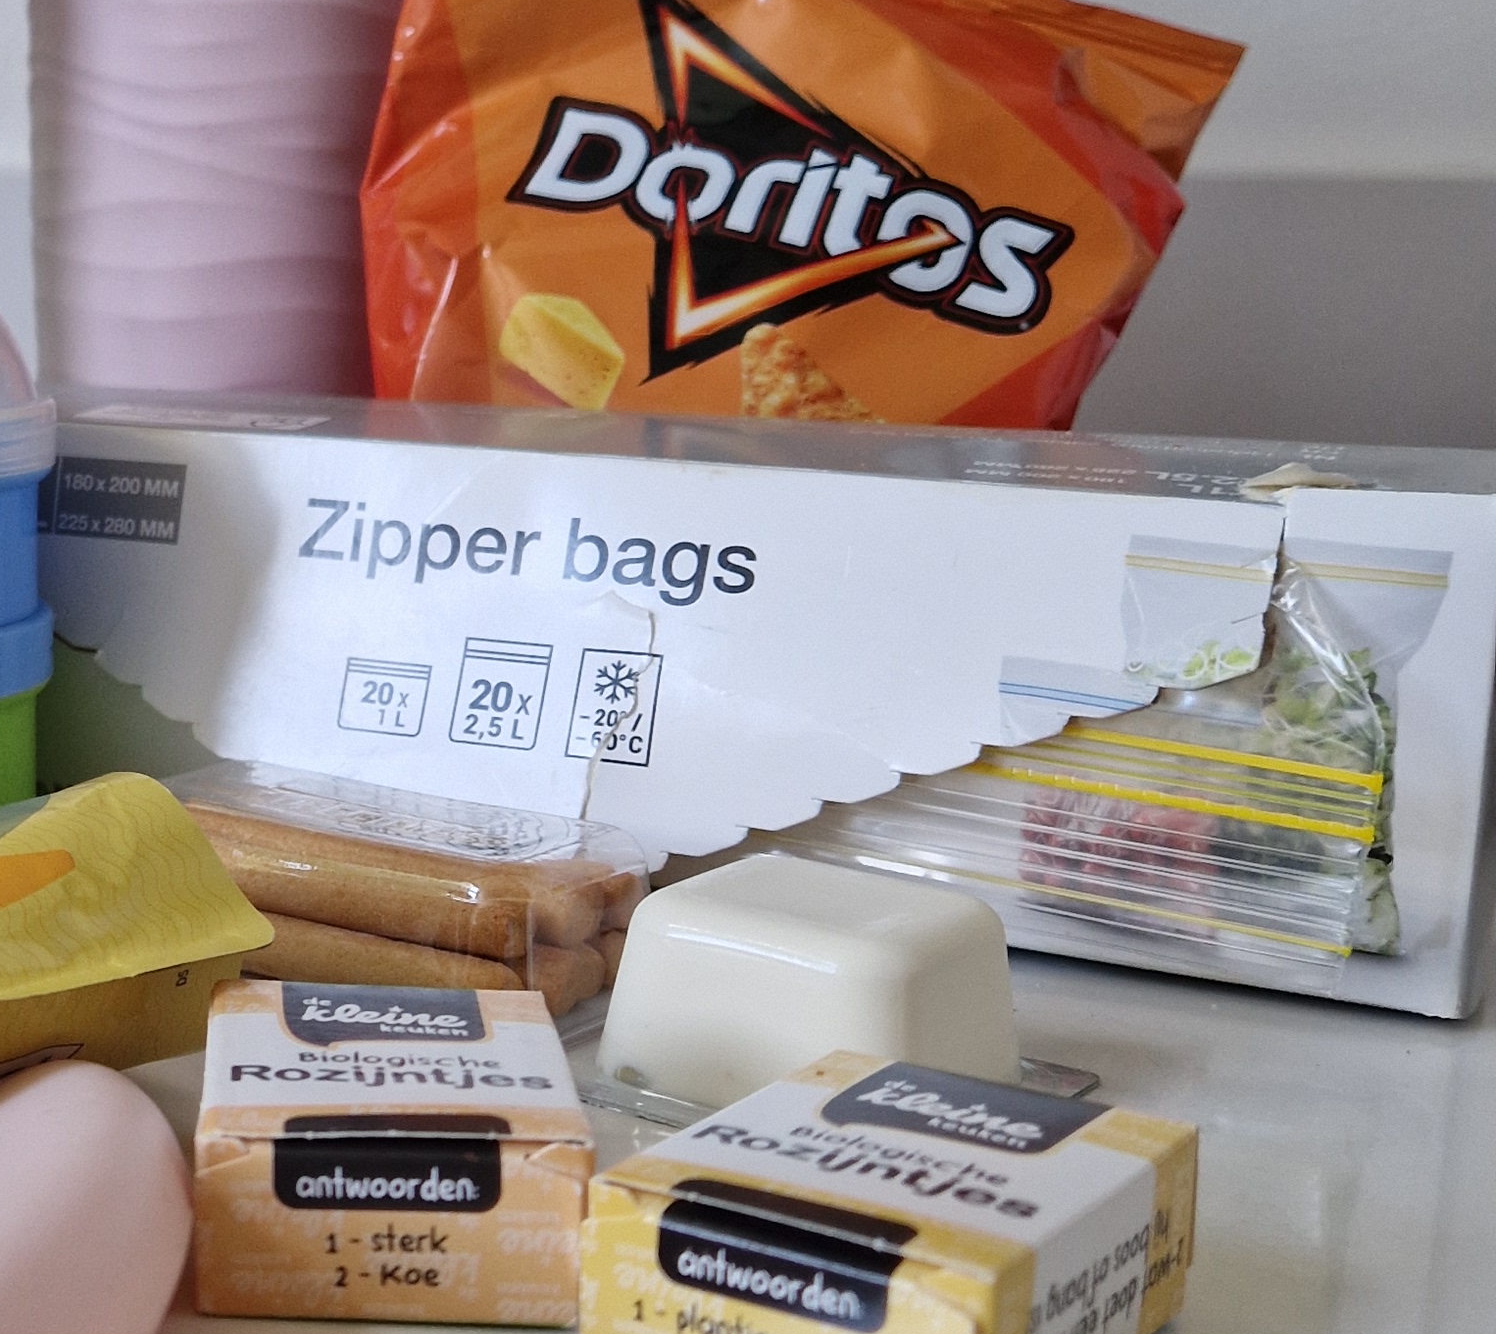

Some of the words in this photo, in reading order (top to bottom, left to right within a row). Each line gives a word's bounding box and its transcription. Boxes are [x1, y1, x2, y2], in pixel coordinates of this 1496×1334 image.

[512, 100, 1071, 329] Doritos
[64, 473, 93, 492] 180
[95, 481, 105, 492] x
[109, 476, 139, 495] 200
[145, 479, 179, 499] MM
[59, 513, 88, 532] 225
[90, 521, 100, 532] x
[104, 517, 135, 536] 280
[140, 520, 174, 540] MM
[299, 497, 541, 583] Zipper
[562, 518, 757, 606] bags
[361, 680, 393, 706] 20
[468, 679, 513, 713] 20
[463, 714, 502, 741] 2,5
[512, 719, 524, 740] L
[303, 996, 331, 1007] de
[301, 1004, 468, 1028] kleine
[379, 1023, 468, 1036] keuken
[298, 1050, 502, 1069] Biologische
[229, 1064, 553, 1090] Rozijntjes
[856, 1083, 1044, 1140] kleine
[788, 1124, 1010, 1187] Biologische
[691, 1123, 1041, 1220] Rozijntjes
[324, 1231, 338, 1255] 1
[371, 1222, 449, 1254] sterk
[333, 1265, 348, 1288] 2
